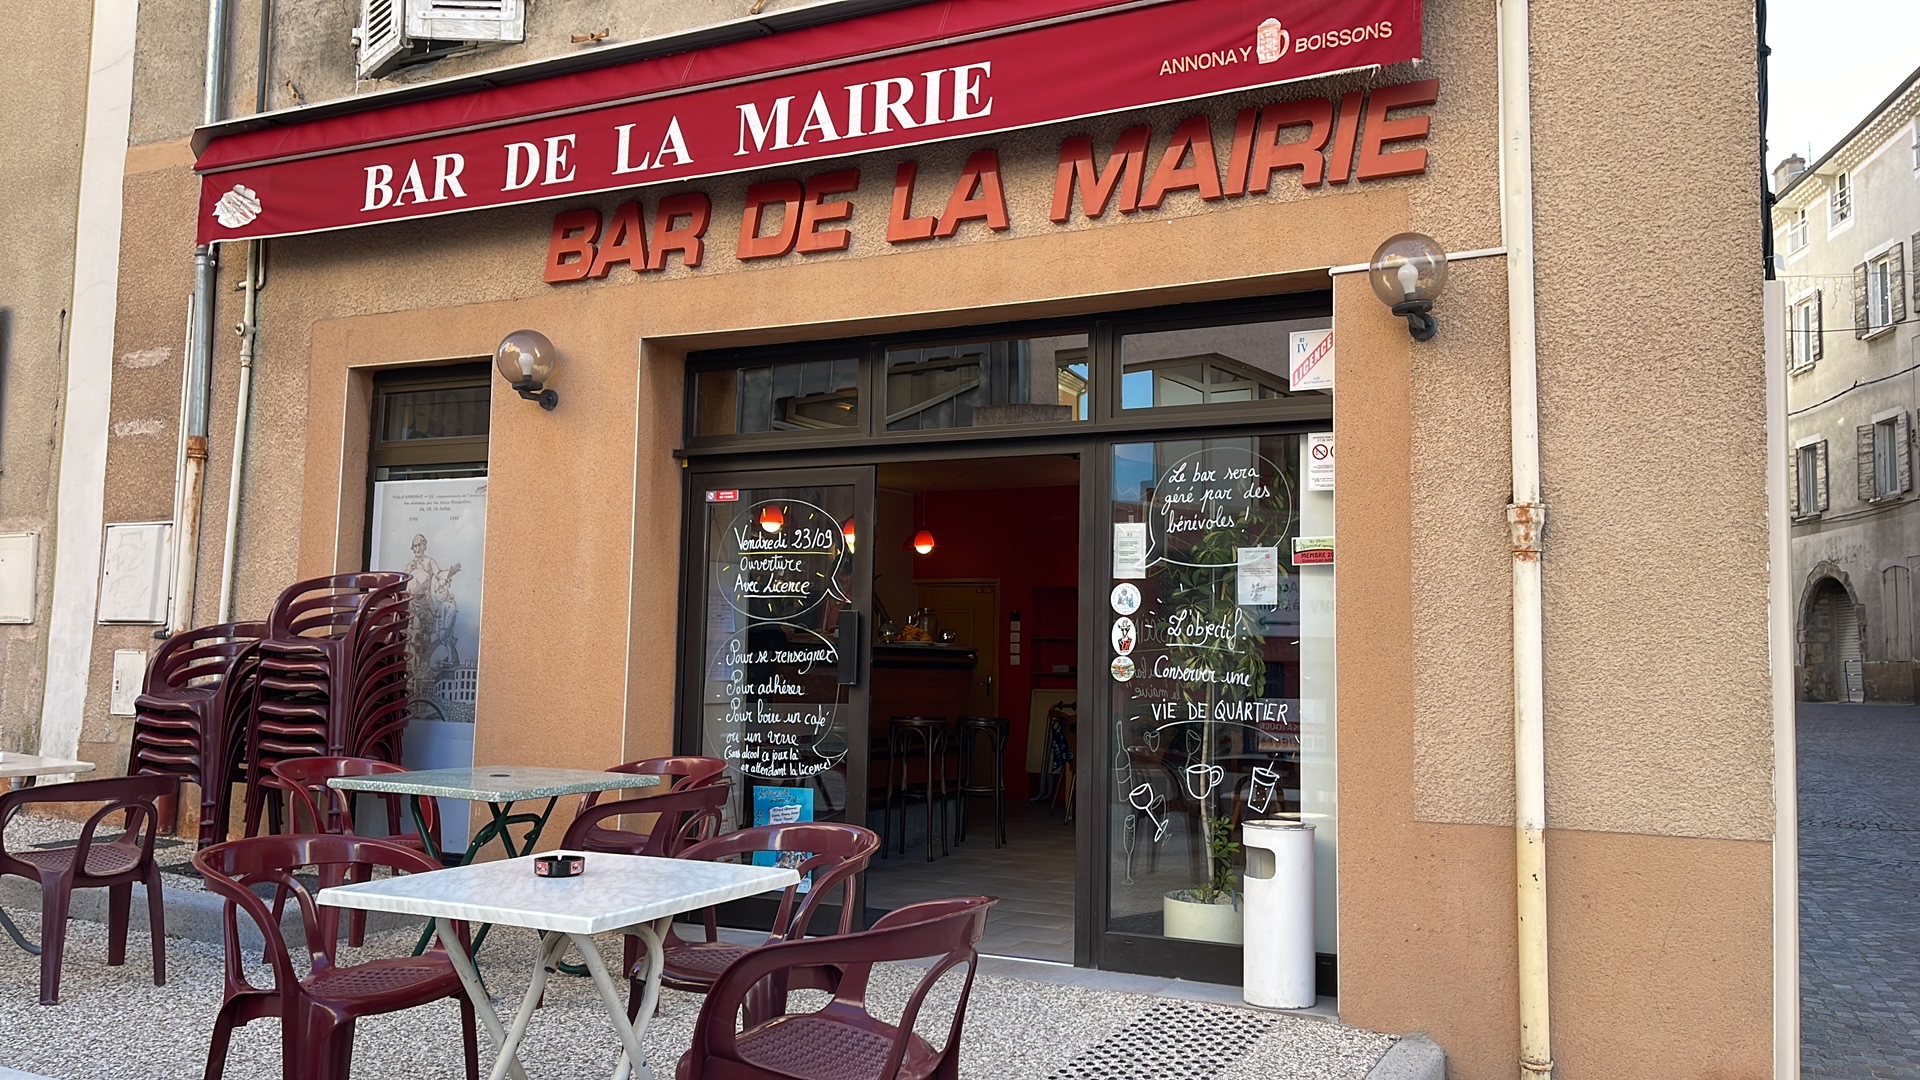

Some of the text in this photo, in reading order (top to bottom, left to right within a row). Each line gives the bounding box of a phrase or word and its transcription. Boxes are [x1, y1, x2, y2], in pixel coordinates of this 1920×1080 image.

[1159, 20, 1393, 76] ANNONAY BOISSONS
[360, 60, 994, 212] BAR DE LA MAIRIE
[543, 78, 1439, 285] BAR DE LA MAIRIE
[1295, 334, 1332, 384] LICENCE
[1297, 343, 1308, 353] IV
[1168, 461, 1260, 484] Le bar sera
[1161, 484, 1271, 515] géré par des
[1166, 505, 1235, 534] bénévoles
[734, 525, 833, 550] Vendredi 23/09
[740, 555, 802, 573] Ouverture
[734, 573, 810, 594] Avec Licence
[726, 639, 834, 674] Pour se renseigner
[726, 670, 804, 696] Pour adhérer
[1154, 655, 1252, 687] Conserver une
[726, 697, 753, 724] Pour
[785, 712, 801, 724] un
[804, 704, 831, 735] café
[1187, 702, 1208, 720] DE
[726, 733, 740, 744] ou
[744, 732, 762, 744] un
[751, 762, 786, 777] attendant
[789, 763, 798, 776] la
[771, 748, 788, 766] jour
